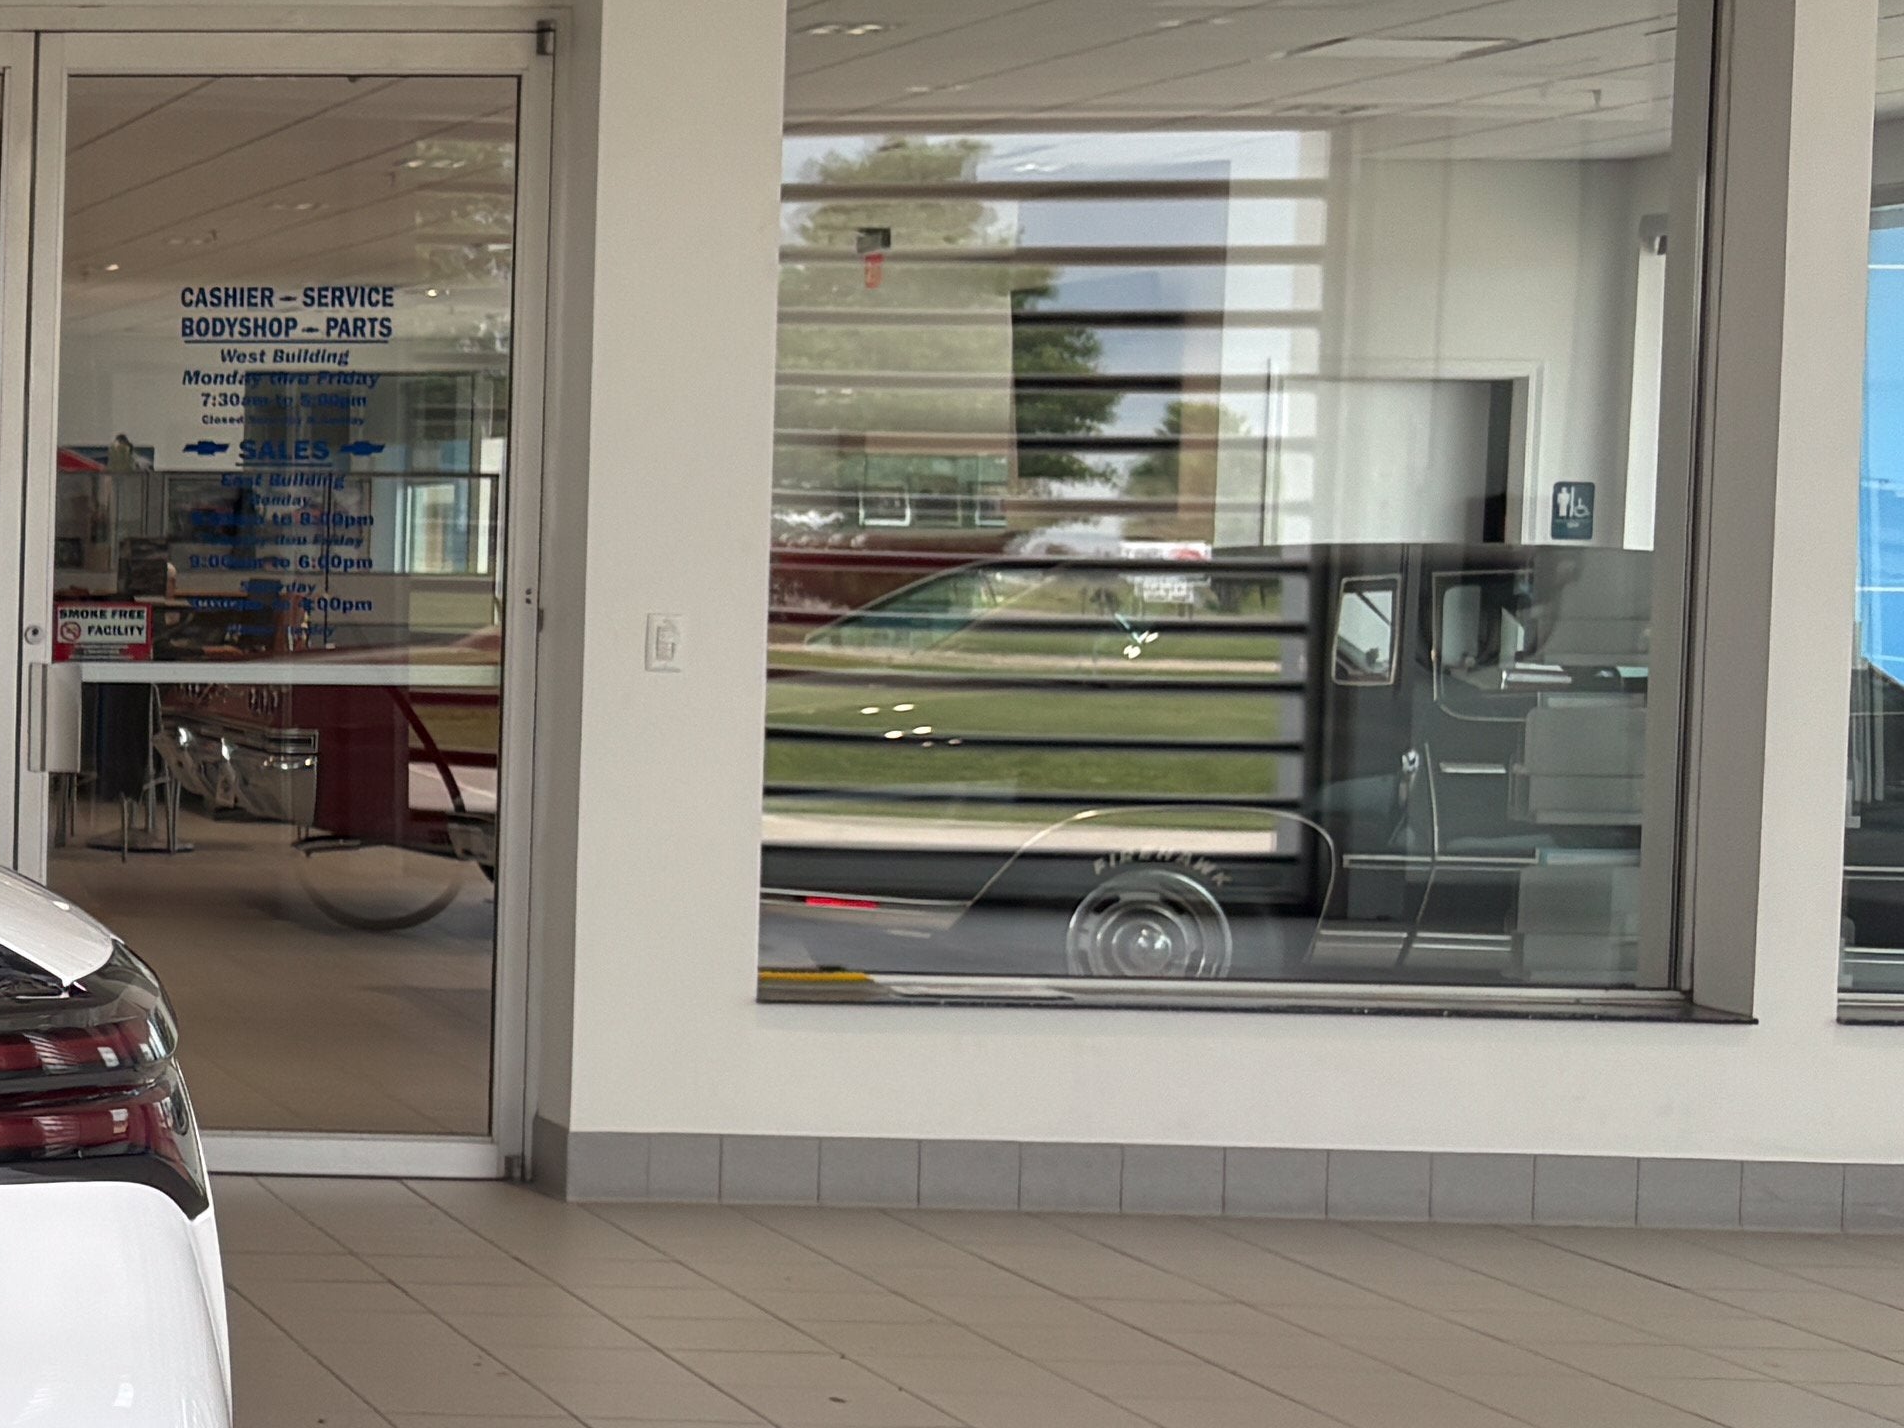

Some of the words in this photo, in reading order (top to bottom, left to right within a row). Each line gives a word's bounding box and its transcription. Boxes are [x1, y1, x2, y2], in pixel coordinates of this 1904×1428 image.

[181, 286, 274, 308] CASHIER
[302, 286, 395, 308] SERVICE
[181, 316, 298, 338] BODYSHOP
[325, 317, 392, 339] PARTS
[220, 348, 266, 363] West
[273, 348, 350, 366] Building
[182, 370, 263, 389] Monday
[239, 440, 330, 460] SALES
[299, 554, 373, 573] 6:00pm
[59, 609, 108, 620] SMOKE
[112, 609, 145, 620] FREE
[87, 625, 144, 636] FACILITY
